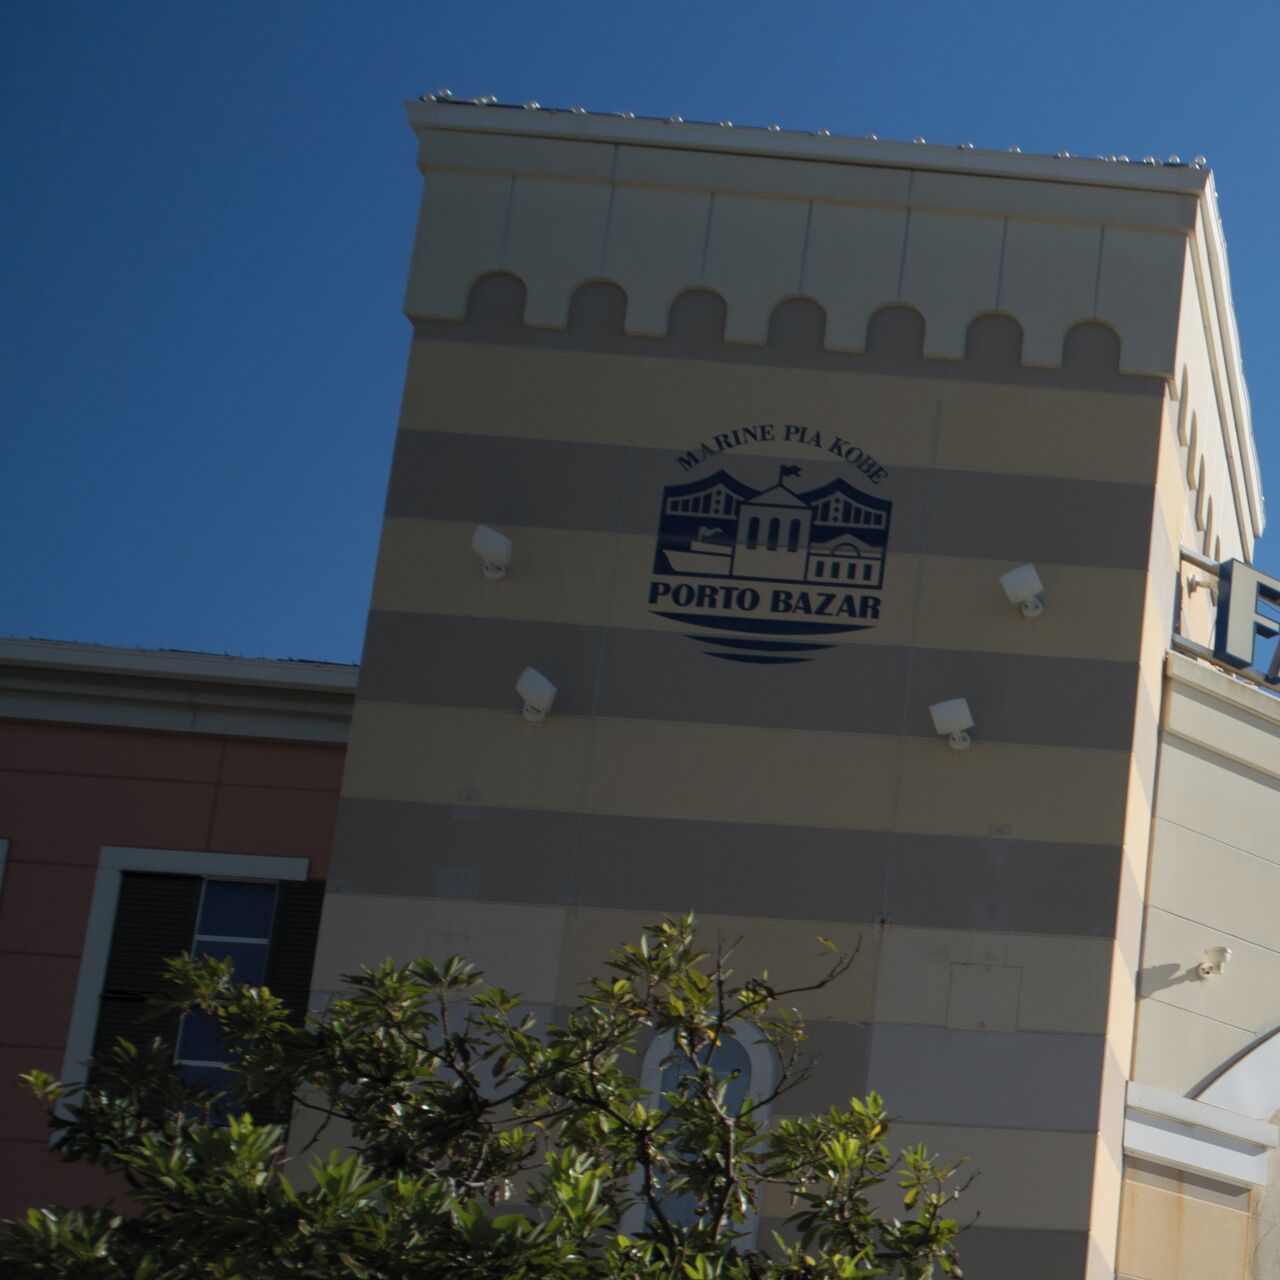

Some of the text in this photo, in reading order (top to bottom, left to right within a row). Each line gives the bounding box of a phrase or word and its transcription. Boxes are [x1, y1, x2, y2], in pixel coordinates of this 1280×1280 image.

[675, 424, 889, 485] MARINE PIA KOBE
[648, 581, 882, 619] PORTO BAZAR
